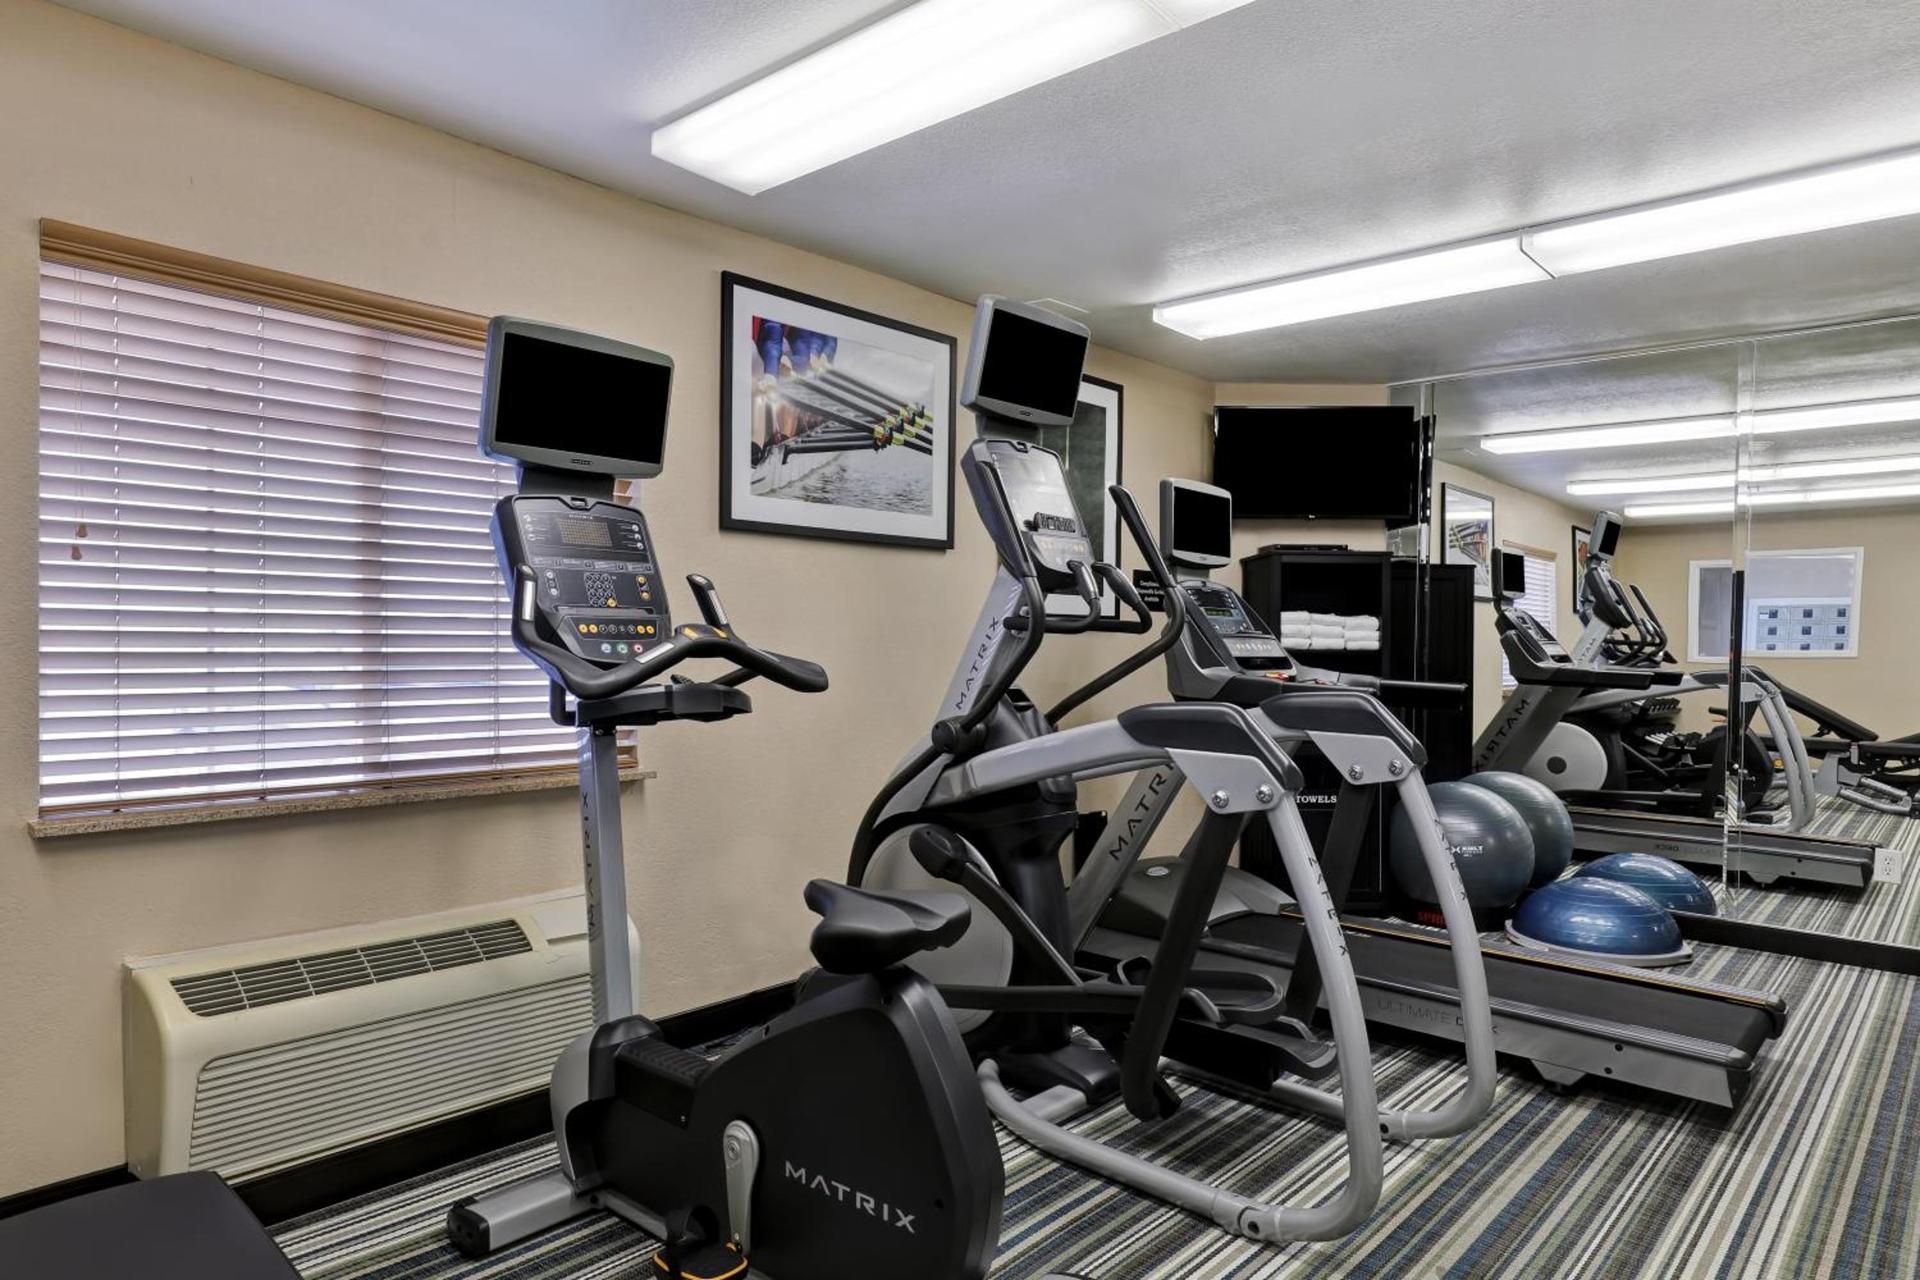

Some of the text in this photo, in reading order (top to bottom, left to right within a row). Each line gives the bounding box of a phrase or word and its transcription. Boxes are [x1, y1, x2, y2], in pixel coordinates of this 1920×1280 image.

[955, 616, 999, 710] MATRIX
[1296, 795, 1337, 803] TOWELS
[1377, 998, 1453, 1025] ULTIMATE
[785, 1160, 916, 1234] MATRIX
